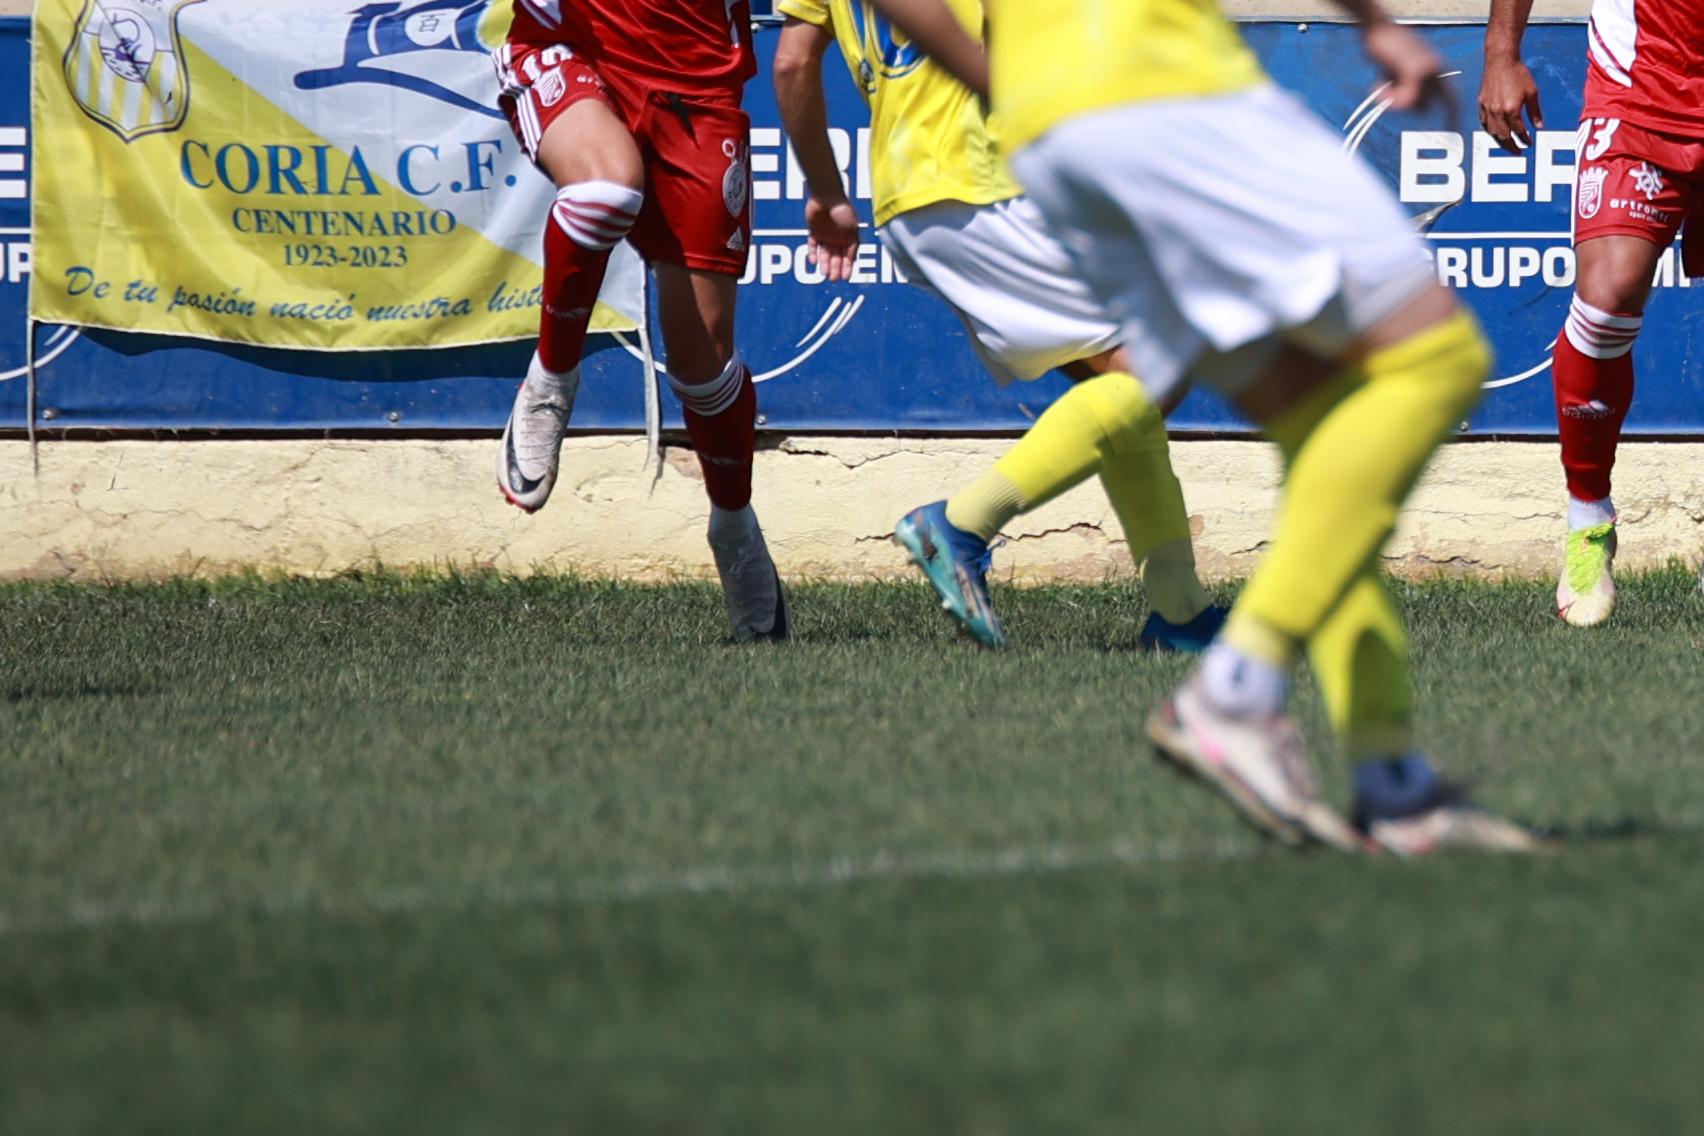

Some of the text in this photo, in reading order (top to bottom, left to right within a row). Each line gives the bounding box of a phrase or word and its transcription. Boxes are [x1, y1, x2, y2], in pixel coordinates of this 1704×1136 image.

[180, 139, 517, 196] CORIA C.F.
[232, 207, 457, 237] CENTENARIO
[281, 244, 409, 268] 1923-2023
[65, 266, 111, 299] De
[123, 279, 159, 304] tu
[166, 285, 257, 316] pasión
[270, 293, 356, 321] nació
[367, 296, 473, 322] nuestra
[487, 280, 543, 312] hist
